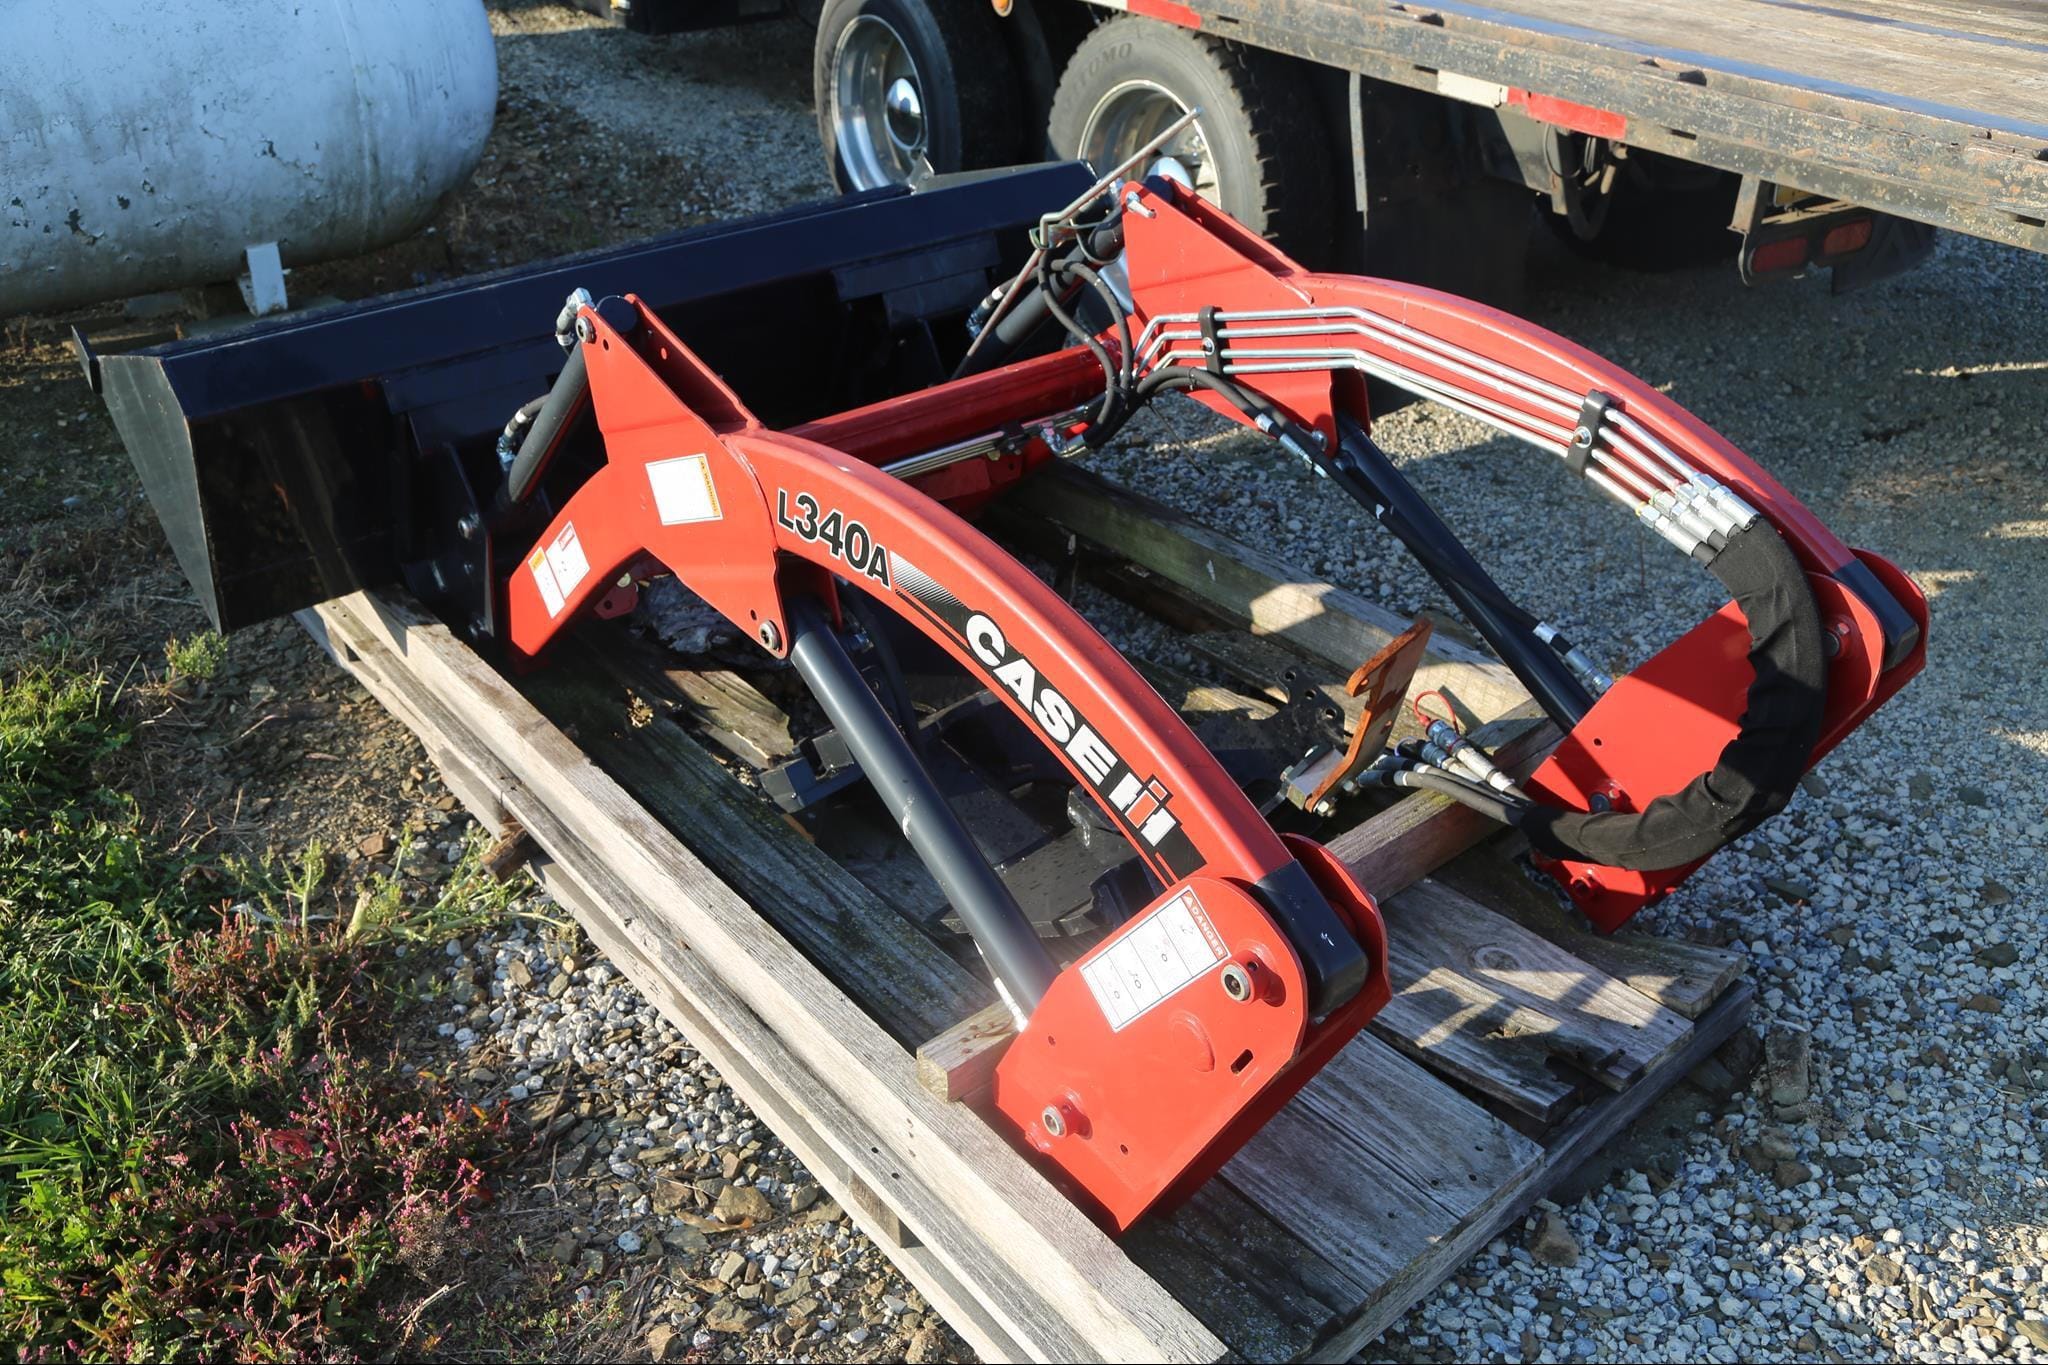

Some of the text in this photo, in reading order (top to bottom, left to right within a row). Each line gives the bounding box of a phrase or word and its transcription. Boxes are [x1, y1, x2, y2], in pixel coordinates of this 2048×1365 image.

[777, 489, 892, 588] L340A
[965, 613, 1118, 786] CASE
[1191, 906, 1223, 957] DANGER
